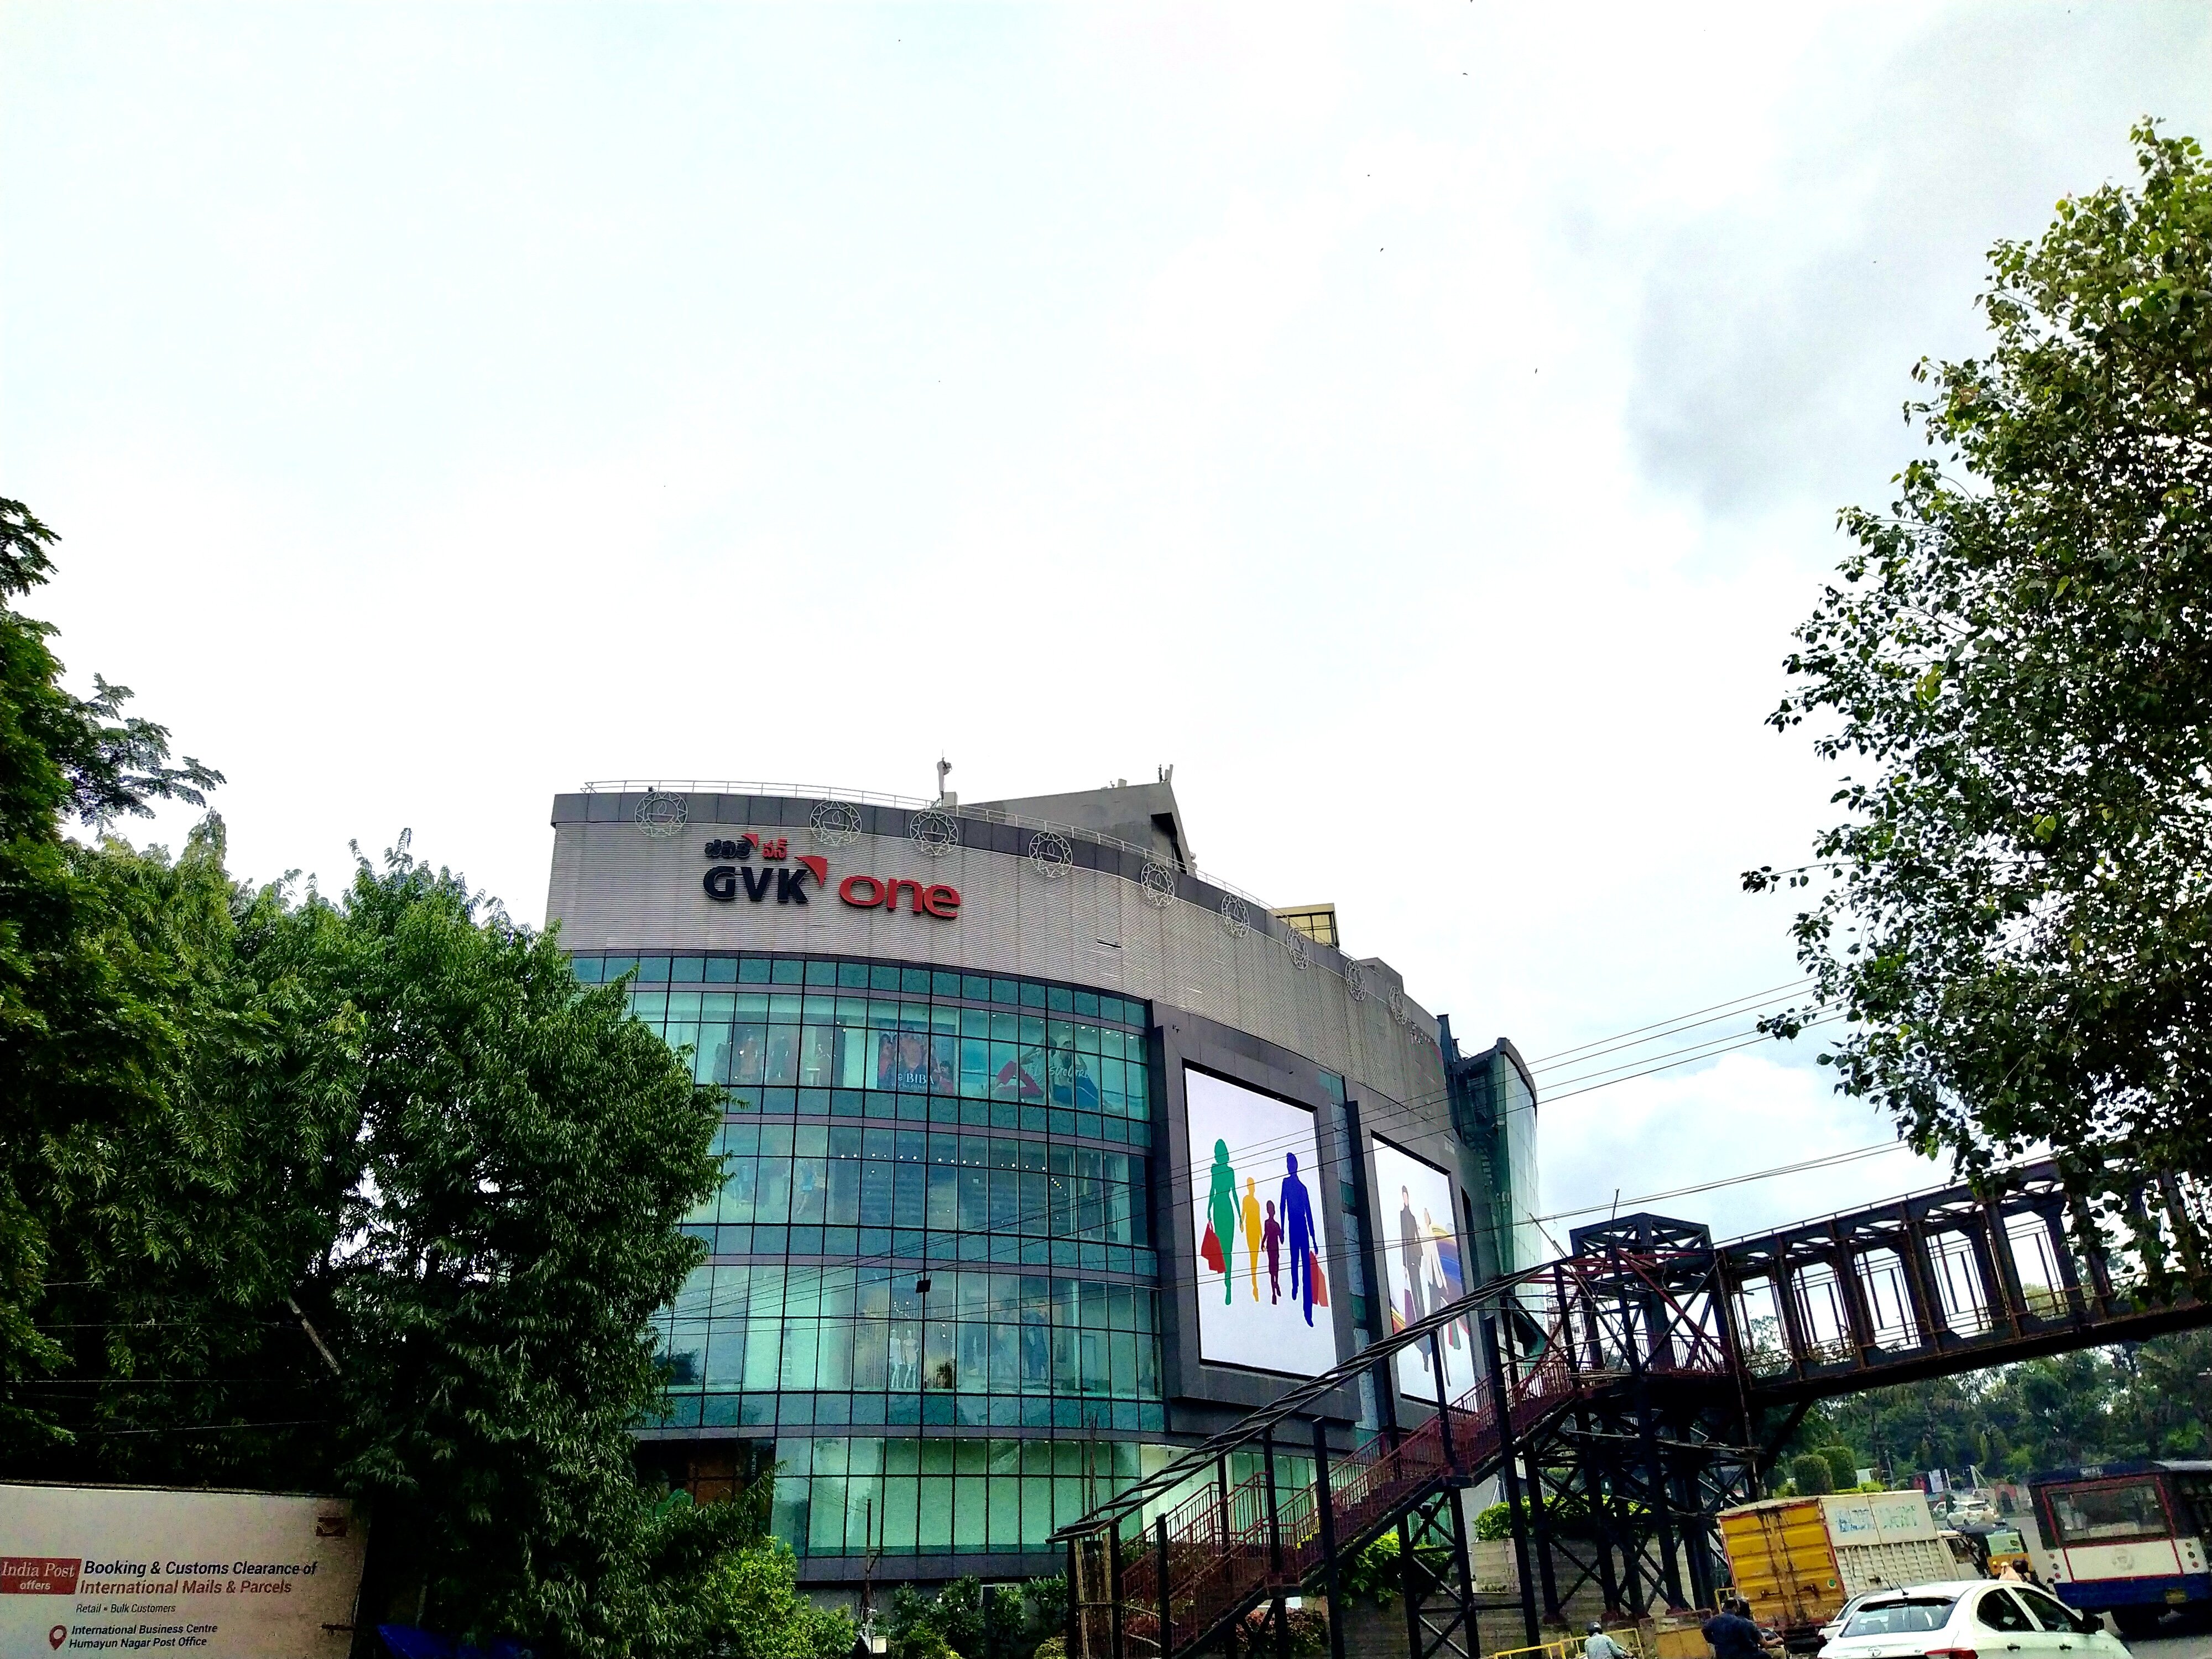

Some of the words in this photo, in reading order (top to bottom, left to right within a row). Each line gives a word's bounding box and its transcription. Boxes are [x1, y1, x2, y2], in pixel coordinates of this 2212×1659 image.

[703, 865, 808, 903] GVK
[839, 875, 961, 918] one
[906, 1073, 935, 1084] BIBA
[1, 1561, 39, 1577] India
[44, 1563, 75, 1577] Post
[84, 1561, 147, 1577] Booking
[150, 1561, 161, 1574] &
[165, 1561, 229, 1574] Customs
[233, 1561, 299, 1575] Clearance
[303, 1561, 318, 1574] of
[20, 1580, 51, 1590] offers
[80, 1579, 178, 1594] International
[182, 1580, 222, 1594] Mails
[226, 1580, 236, 1594] &
[240, 1579, 292, 1593] Parcels
[76, 1604, 101, 1613] Retail
[111, 1604, 129, 1613] Bulk
[131, 1604, 176, 1613] Customers
[71, 1625, 137, 1635] International
[139, 1624, 184, 1635] Business
[186, 1624, 218, 1634] Centre
[69, 1638, 118, 1650] Humayun
[120, 1637, 152, 1650] Nagar
[153, 1637, 176, 1647] Post
[178, 1636, 207, 1646] Office
